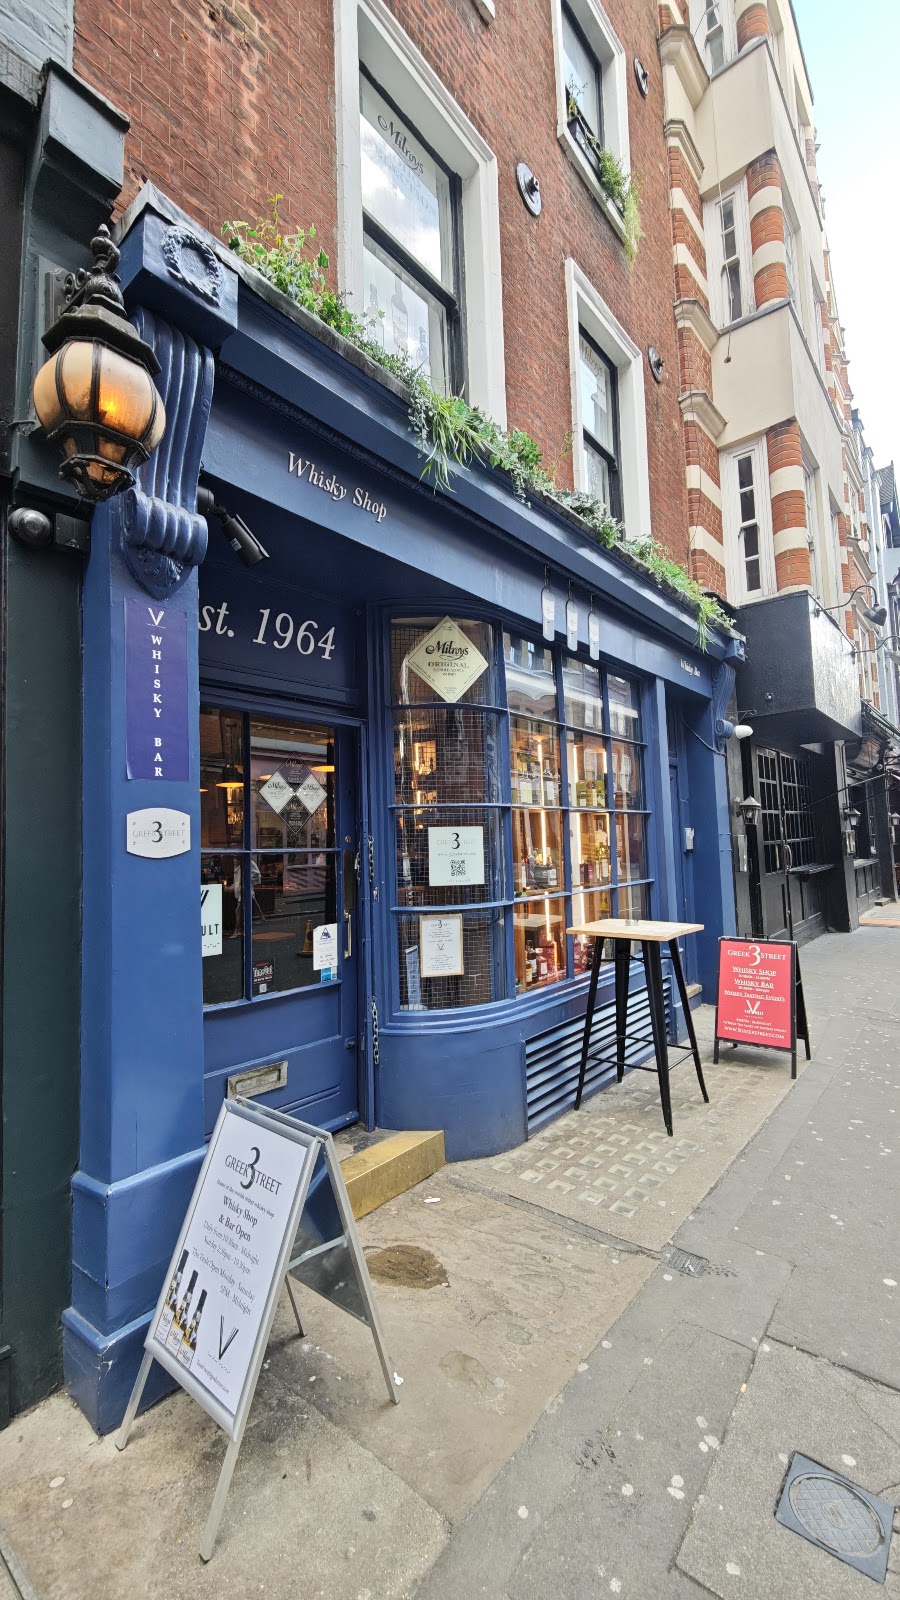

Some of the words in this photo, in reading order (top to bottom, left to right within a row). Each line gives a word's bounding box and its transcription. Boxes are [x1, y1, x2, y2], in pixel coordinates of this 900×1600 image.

[288, 451, 347, 501] Whisky
[352, 487, 387, 523] Shop
[198, 601, 235, 638] st.
[252, 608, 335, 660] 1964
[150, 634, 163, 718] WHISKY
[153, 737, 164, 777] BAR
[132, 829, 158, 838] GREEK
[151, 820, 163, 843] 3
[451, 832, 460, 850] 3
[727, 949, 750, 957] GREEK
[760, 952, 787, 960] STREET
[748, 945, 761, 967] 3
[732, 966, 757, 974] WHISKY
[758, 968, 777, 976] SHOP
[734, 979, 760, 987] WHISKY
[225, 1154, 251, 1178] GREEK
[240, 1146, 260, 1190] 3
[223, 1195, 243, 1218] Whisky
[243, 1208, 258, 1228] Shop
[218, 1213, 225, 1224] &
[224, 1216, 235, 1231] Bar
[235, 1224, 251, 1242] Open
[209, 1260, 220, 1273] Open
